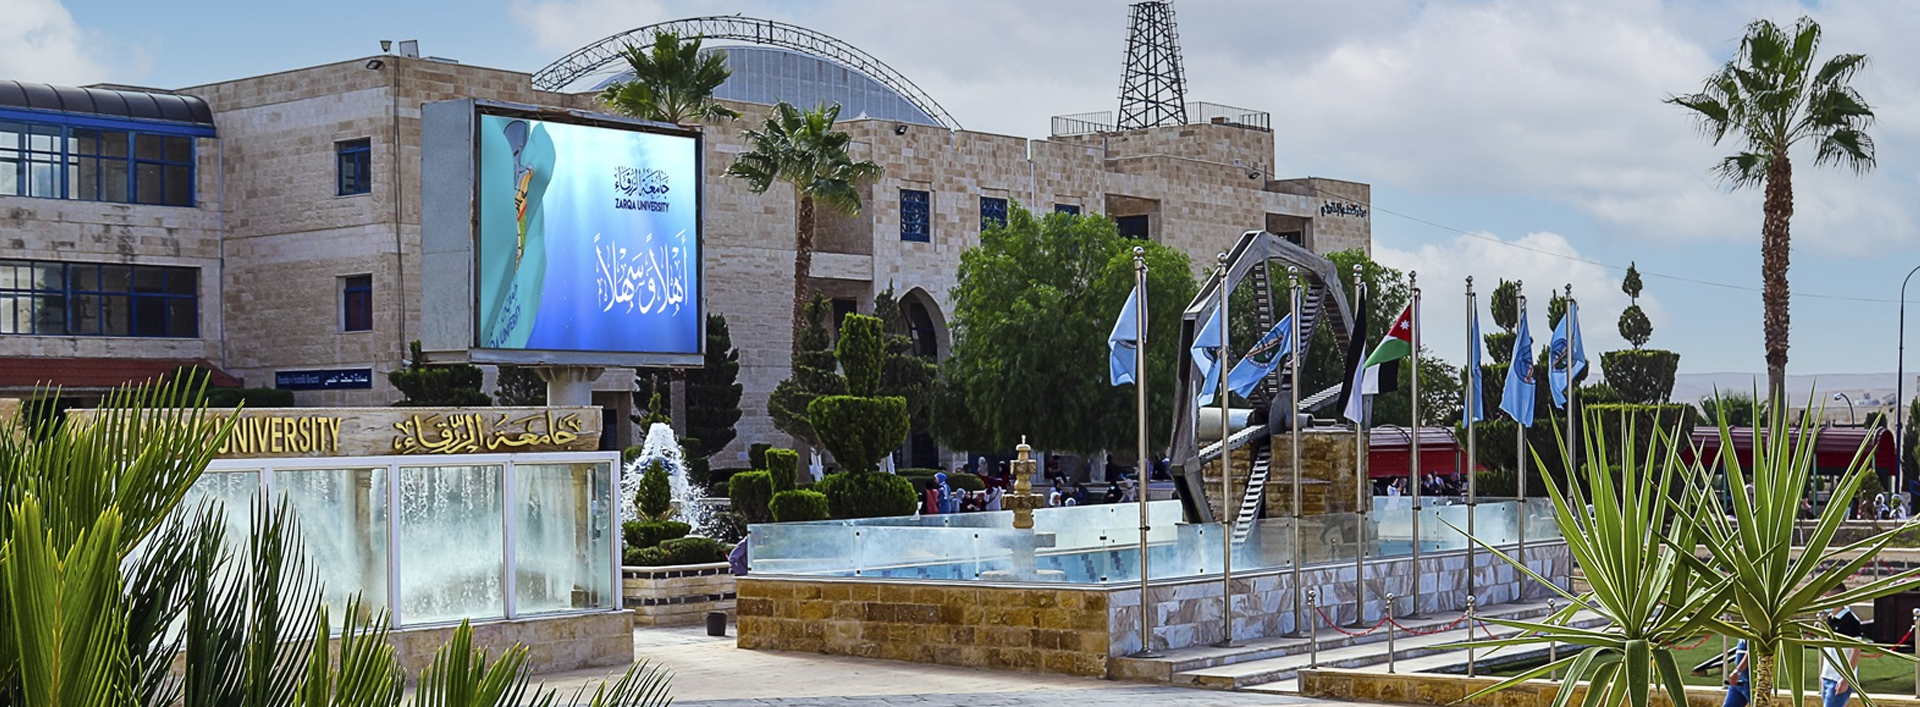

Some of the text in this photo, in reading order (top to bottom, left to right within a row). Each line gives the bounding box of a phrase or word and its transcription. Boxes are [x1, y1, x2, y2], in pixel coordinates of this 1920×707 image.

[615, 198, 670, 213] ZARQA UNIVERSITY
[215, 416, 342, 454] UNIVERSITY
